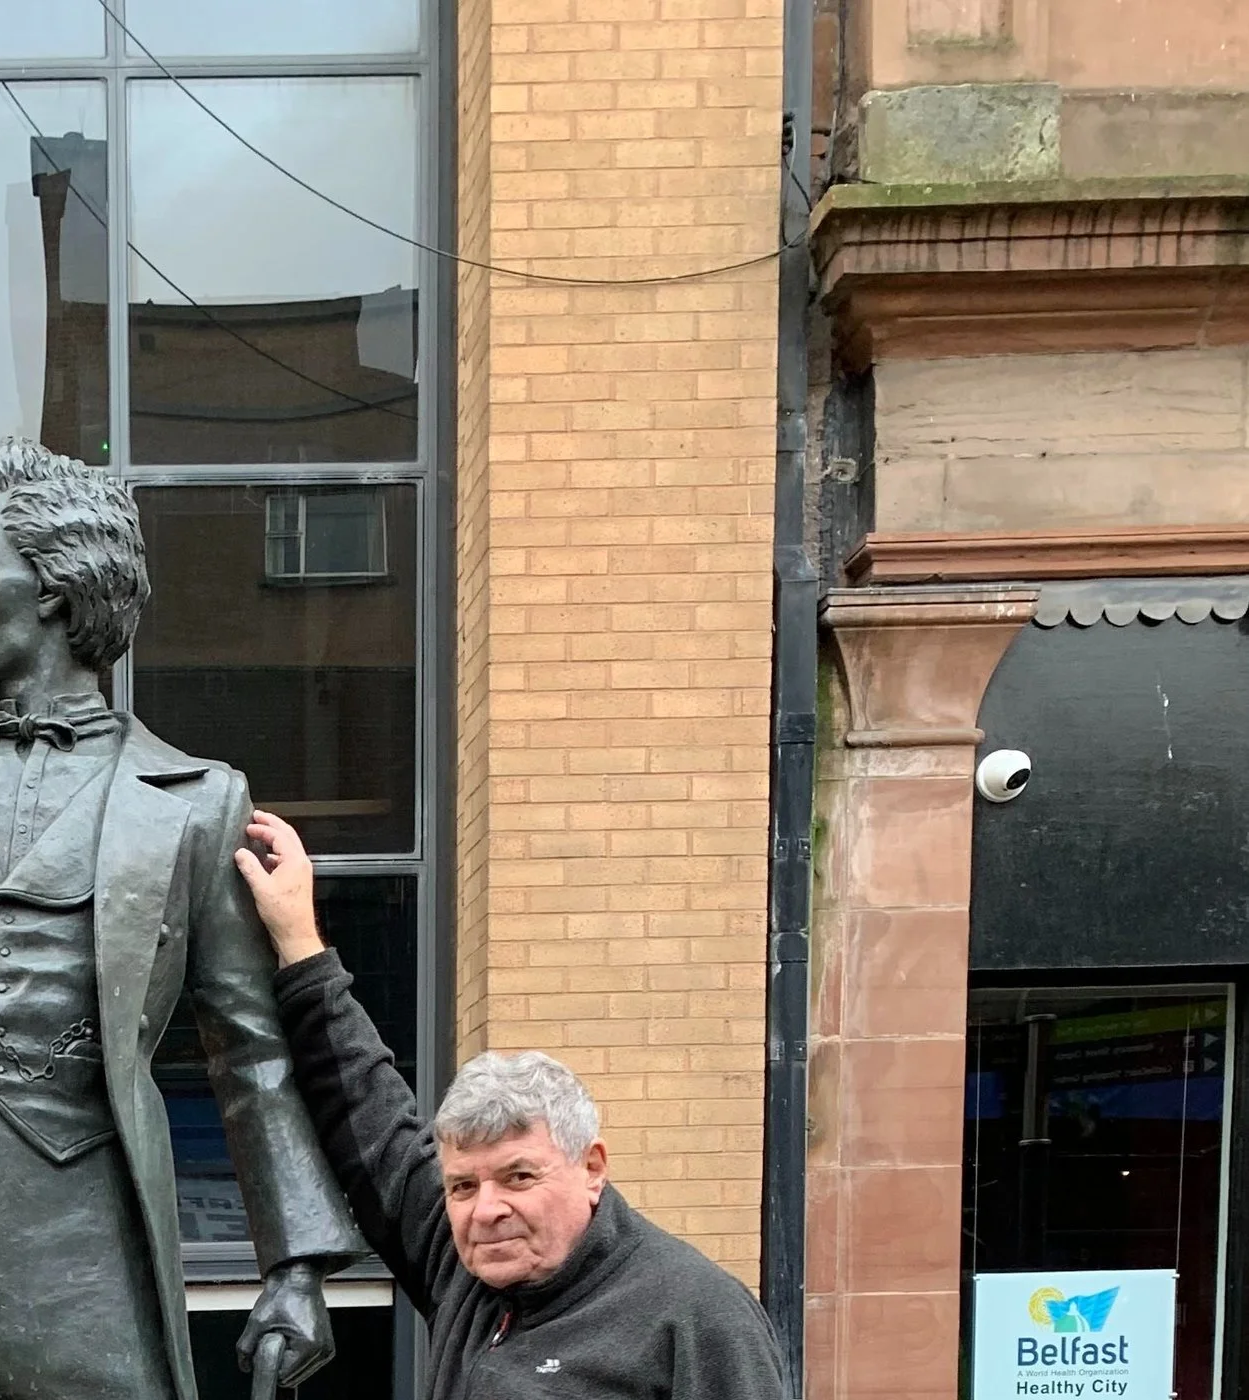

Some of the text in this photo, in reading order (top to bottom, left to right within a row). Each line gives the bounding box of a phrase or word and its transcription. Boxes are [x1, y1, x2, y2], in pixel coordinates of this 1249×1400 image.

[1018, 1335, 1129, 1366] Belfast
[1026, 1369, 1049, 1377] World
[1051, 1368, 1076, 1376] Health
[1079, 1367, 1129, 1377] Organization
[1017, 1379, 1128, 1397] Healthy City
